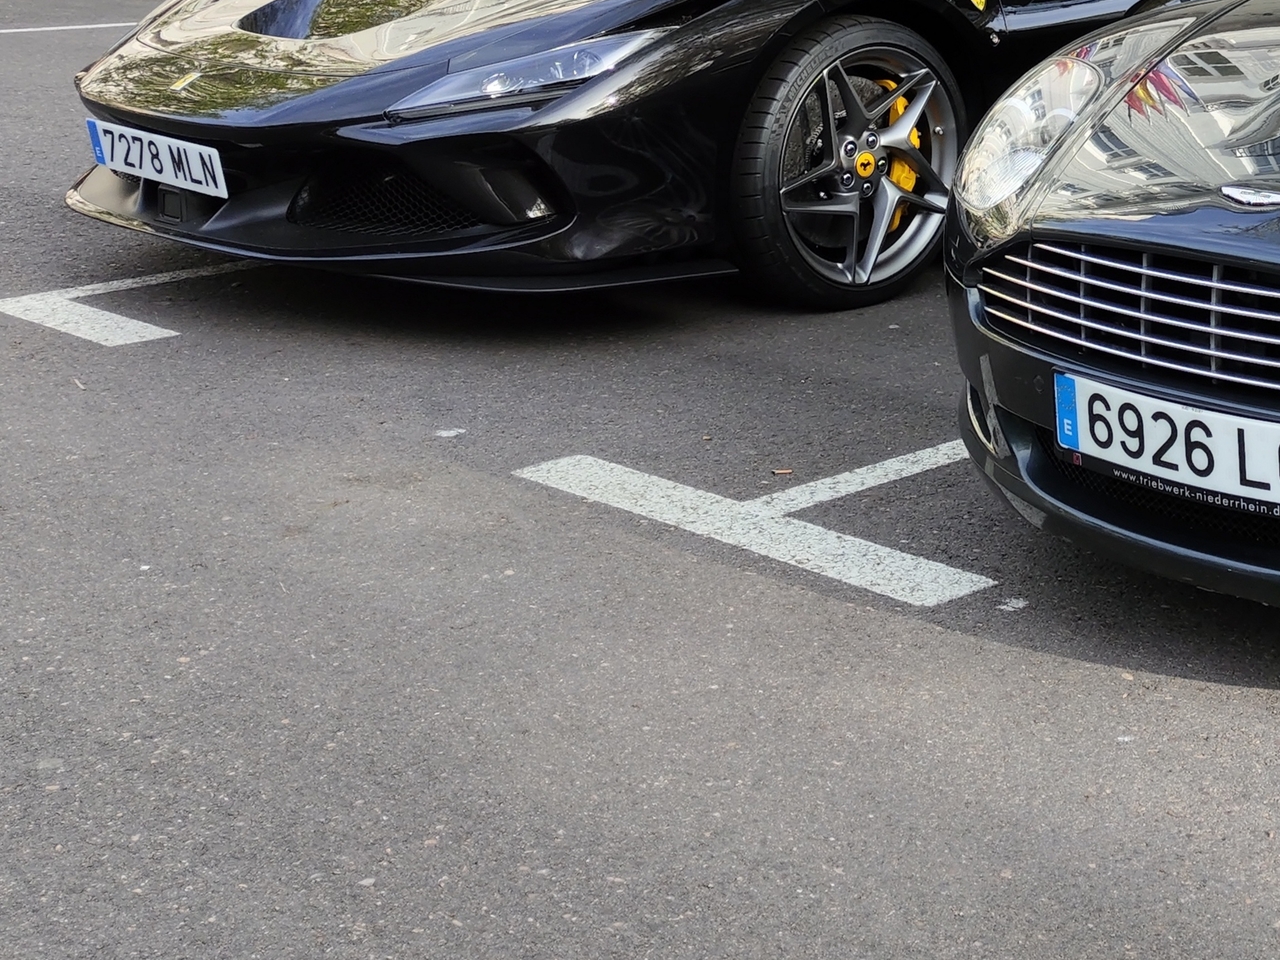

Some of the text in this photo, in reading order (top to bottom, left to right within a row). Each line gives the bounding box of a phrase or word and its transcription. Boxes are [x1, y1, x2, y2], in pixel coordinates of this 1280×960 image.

[102, 128, 164, 175] 7278
[168, 144, 219, 189] MLN
[1063, 418, 1073, 436] E
[1087, 392, 1215, 478] 6926
